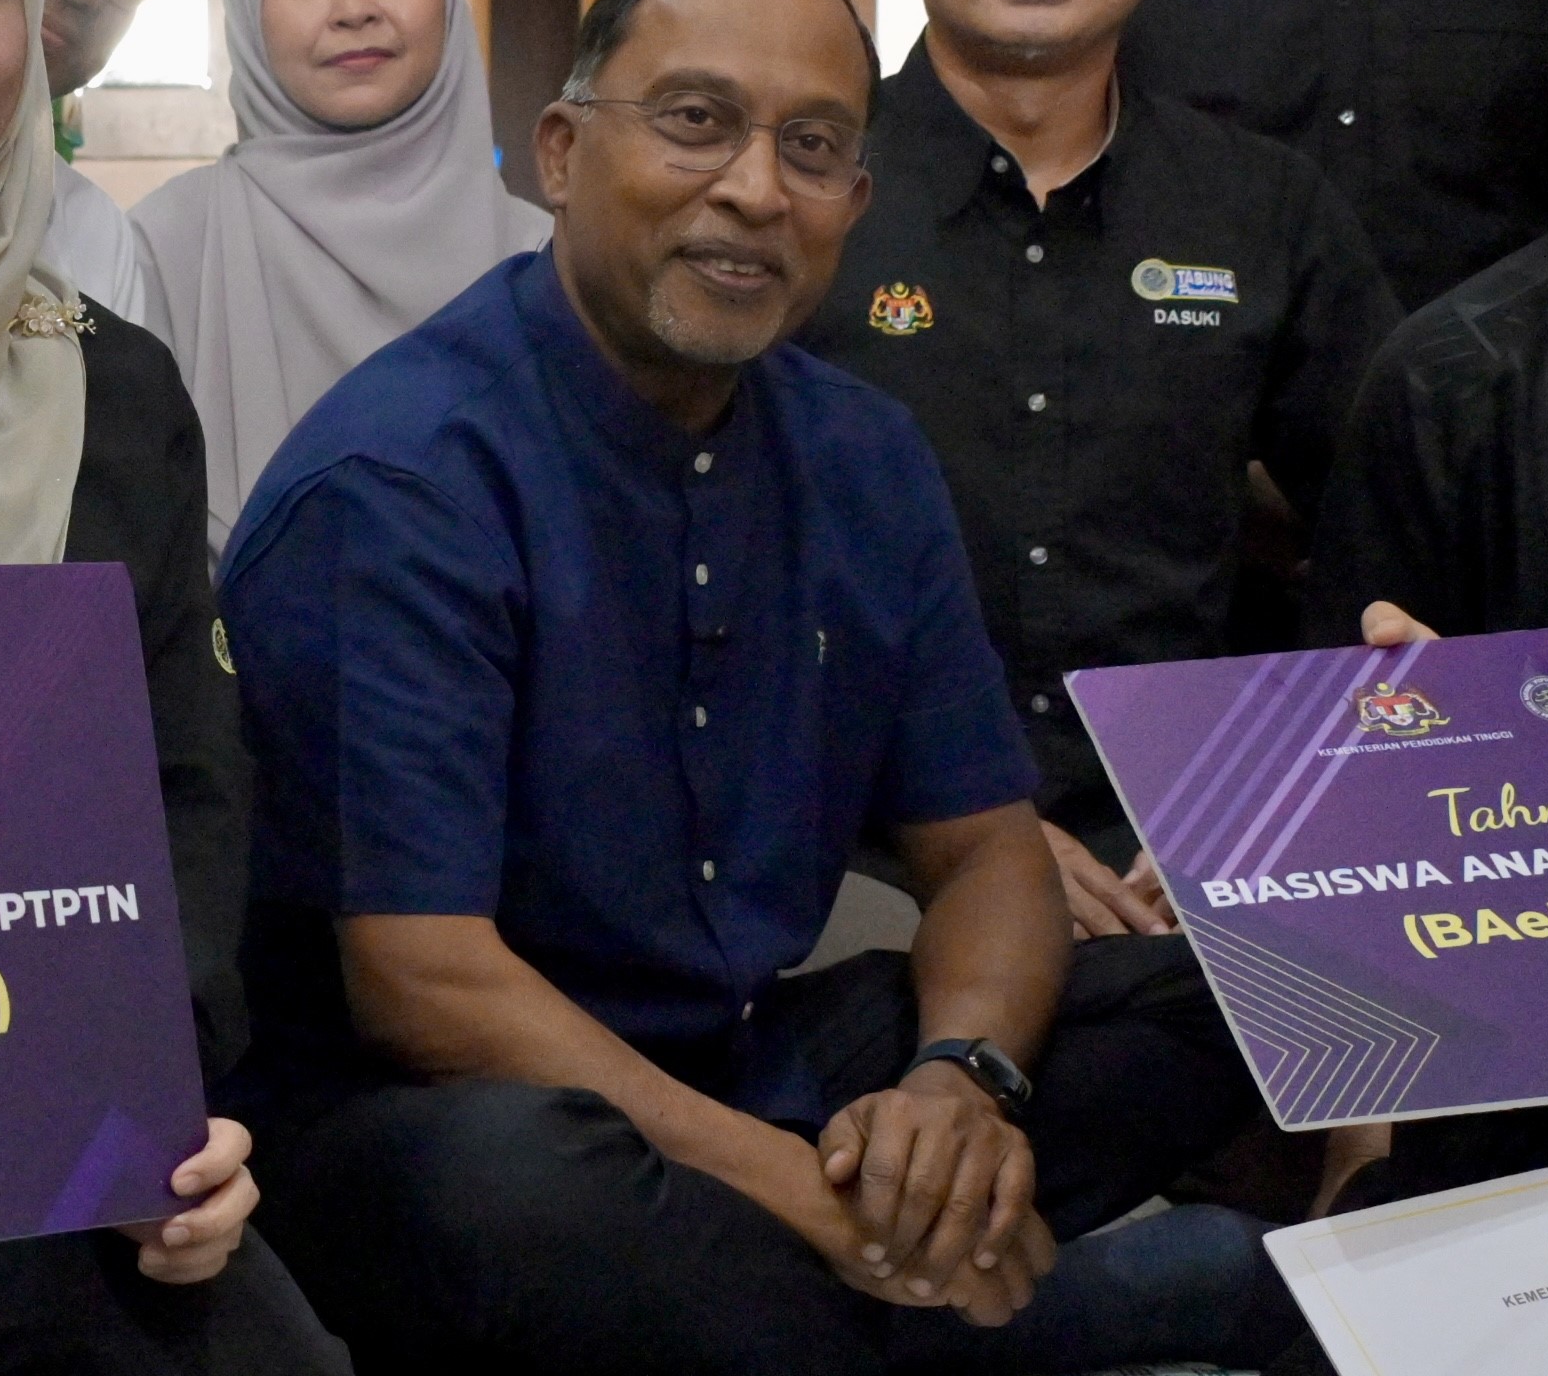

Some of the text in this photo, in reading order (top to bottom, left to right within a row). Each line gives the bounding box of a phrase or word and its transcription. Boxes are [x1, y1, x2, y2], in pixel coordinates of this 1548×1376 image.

[1176, 269, 1234, 289] TABUNG
[1154, 308, 1220, 326] DASUKI
[1317, 730, 1513, 757] KEMENTERIAN PENDIDIKAN TINGGI
[1201, 859, 1453, 910] BIASISWA
